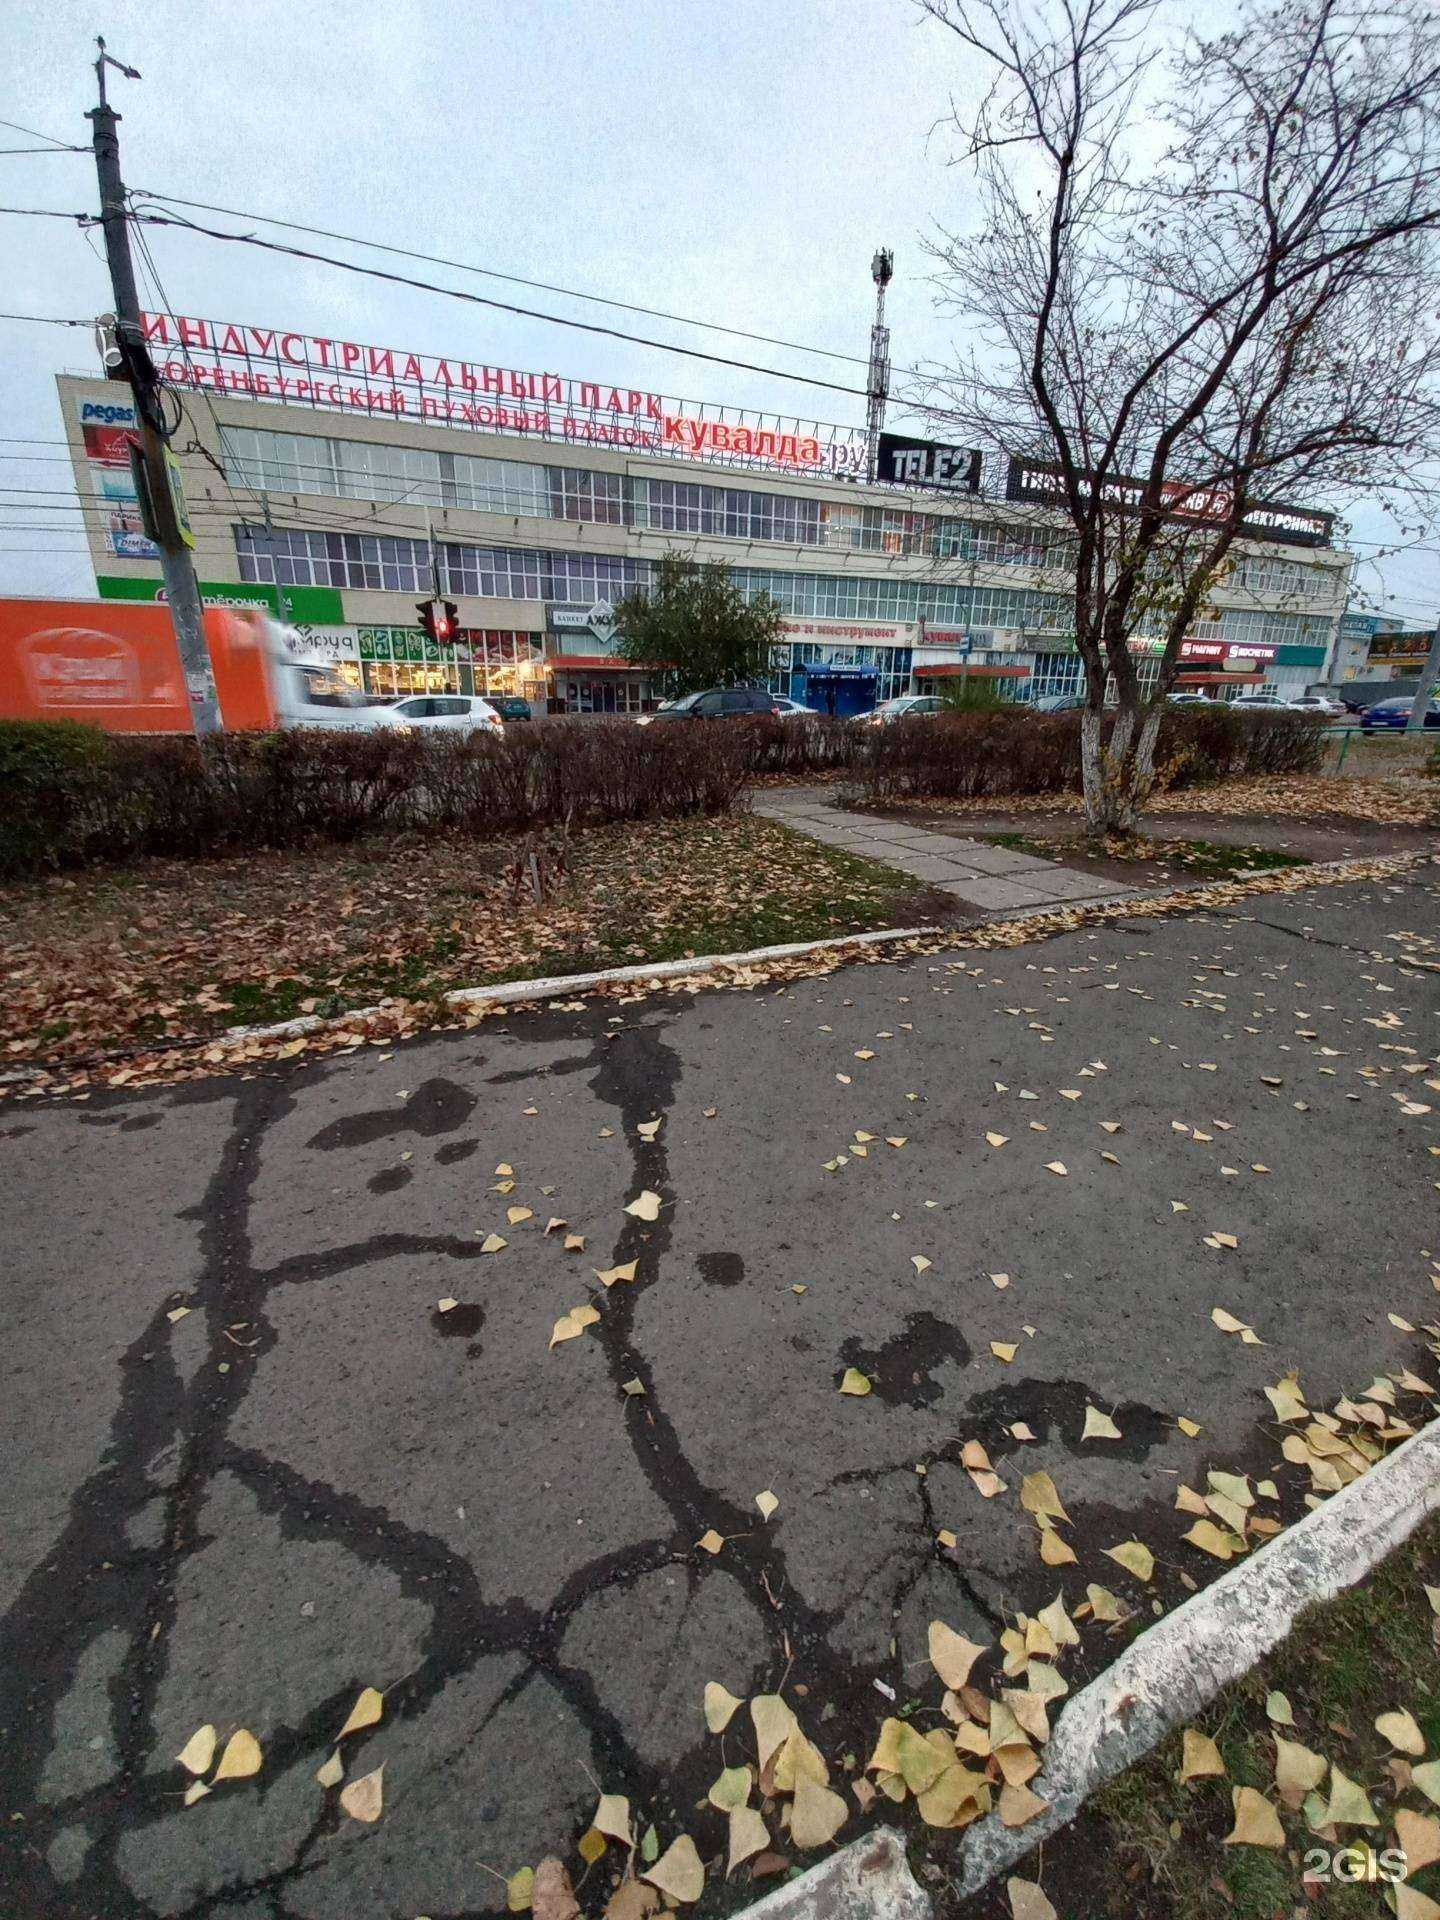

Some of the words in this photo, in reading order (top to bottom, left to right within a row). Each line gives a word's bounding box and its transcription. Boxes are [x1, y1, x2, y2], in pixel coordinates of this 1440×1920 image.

[139, 311, 562, 404] ИНДУСТРИАЛЬНЫЙ
[580, 381, 663, 420] ПАРК
[82, 403, 133, 423] pegas
[664, 415, 868, 473] кувалда.ру
[892, 447, 973, 489] TELE2
[1242, 509, 1326, 537] ЛЕКТРОНИКИ
